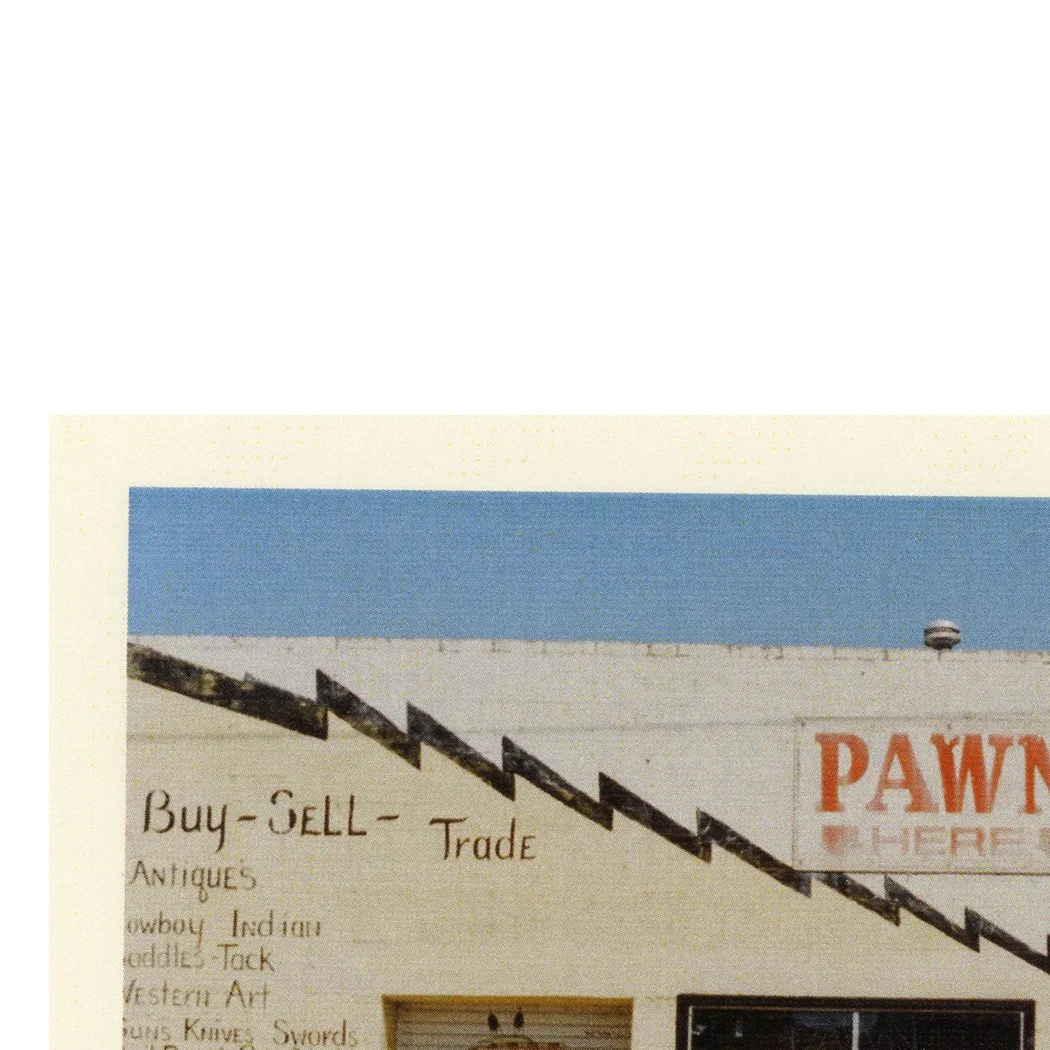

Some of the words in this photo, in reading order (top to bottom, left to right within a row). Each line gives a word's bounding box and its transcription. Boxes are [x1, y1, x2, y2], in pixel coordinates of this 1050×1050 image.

[873, 825, 1025, 856] HERE
[127, 912, 203, 947] owboy
[226, 980, 270, 1009] Art
[272, 1019, 359, 1047] Swords
